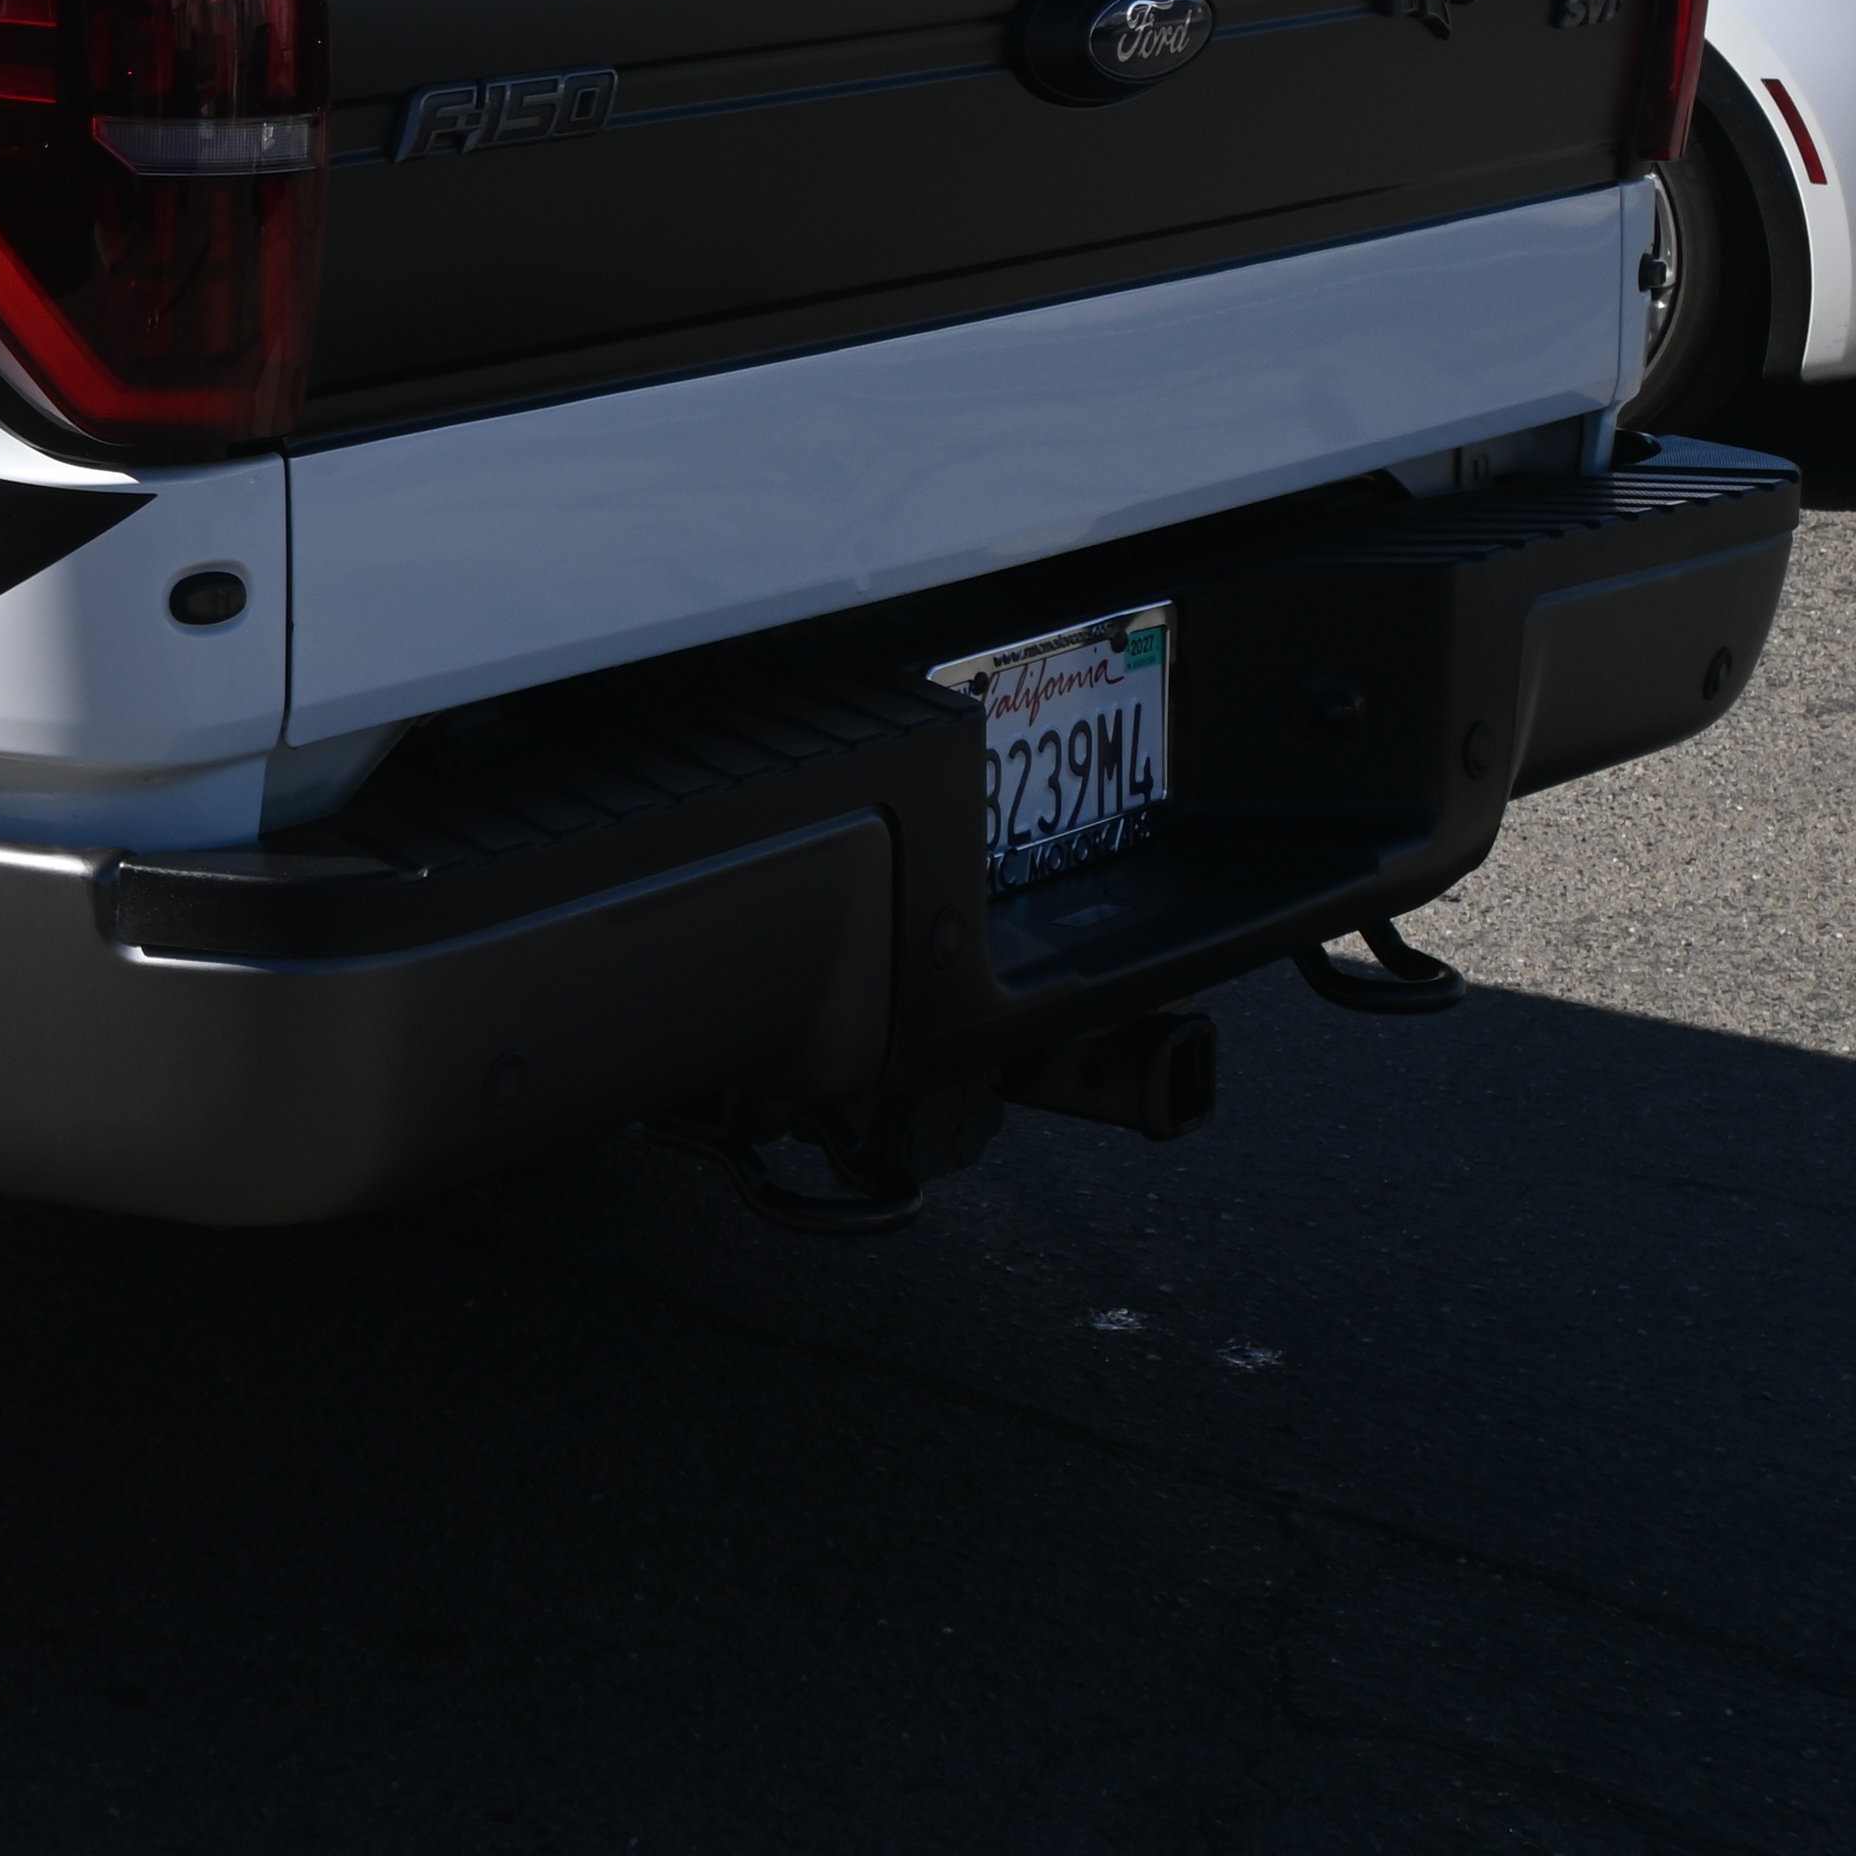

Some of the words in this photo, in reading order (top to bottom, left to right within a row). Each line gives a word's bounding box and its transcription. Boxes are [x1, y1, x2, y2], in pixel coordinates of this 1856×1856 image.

[395, 66, 619, 163] F-150
[1130, 634, 1154, 656] 2027
[985, 658, 1125, 727] California
